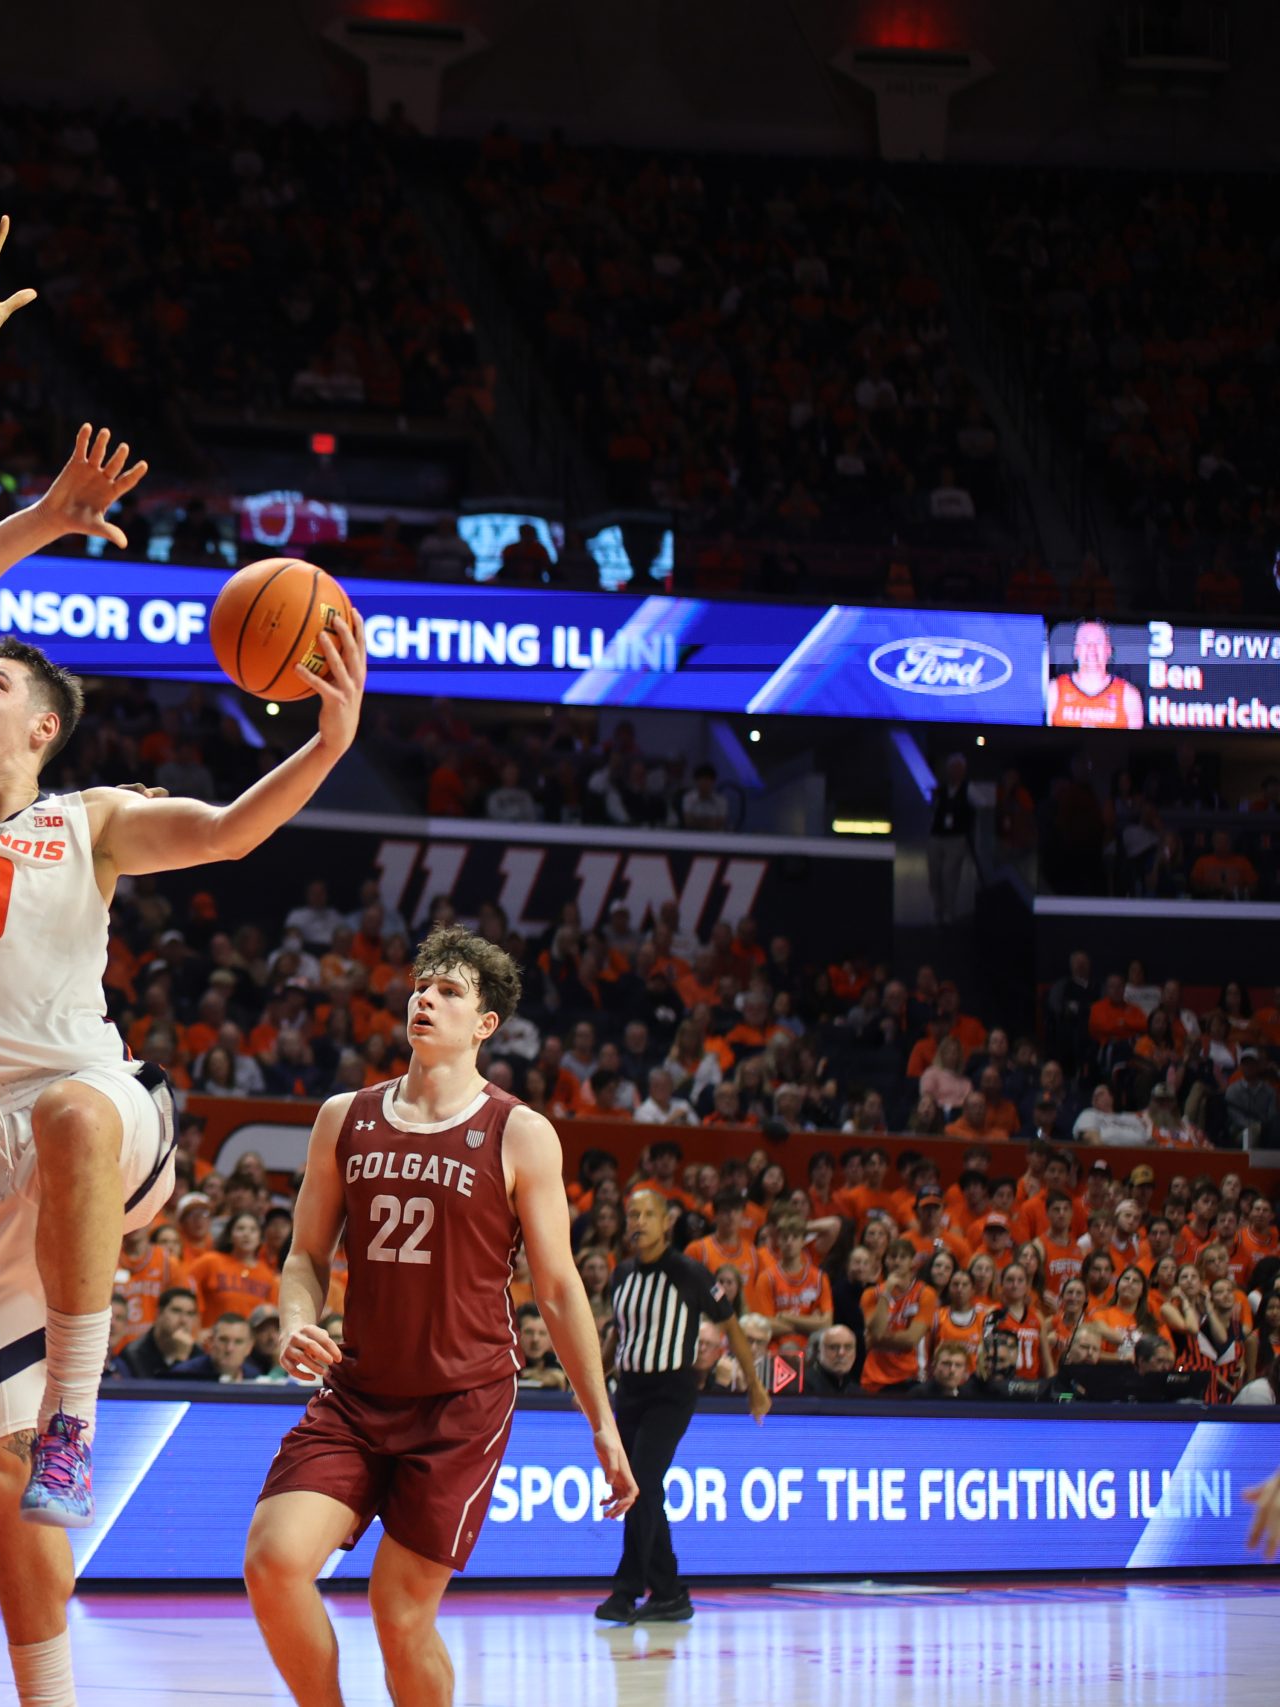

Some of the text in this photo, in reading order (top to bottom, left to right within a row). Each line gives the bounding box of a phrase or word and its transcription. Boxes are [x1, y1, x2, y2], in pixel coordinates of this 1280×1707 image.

[139, 599, 206, 645] OF
[364, 615, 540, 666] GHTING
[553, 626, 676, 673] ILLINI
[1149, 621, 1173, 657] 3
[896, 643, 984, 686] Ford
[1149, 659, 1203, 690] Ben
[346, 1152, 476, 1197] COLGATE
[367, 1195, 435, 1264] 22
[488, 1465, 1231, 1523] SPONOR OF THE FIGHTING ILLINI
